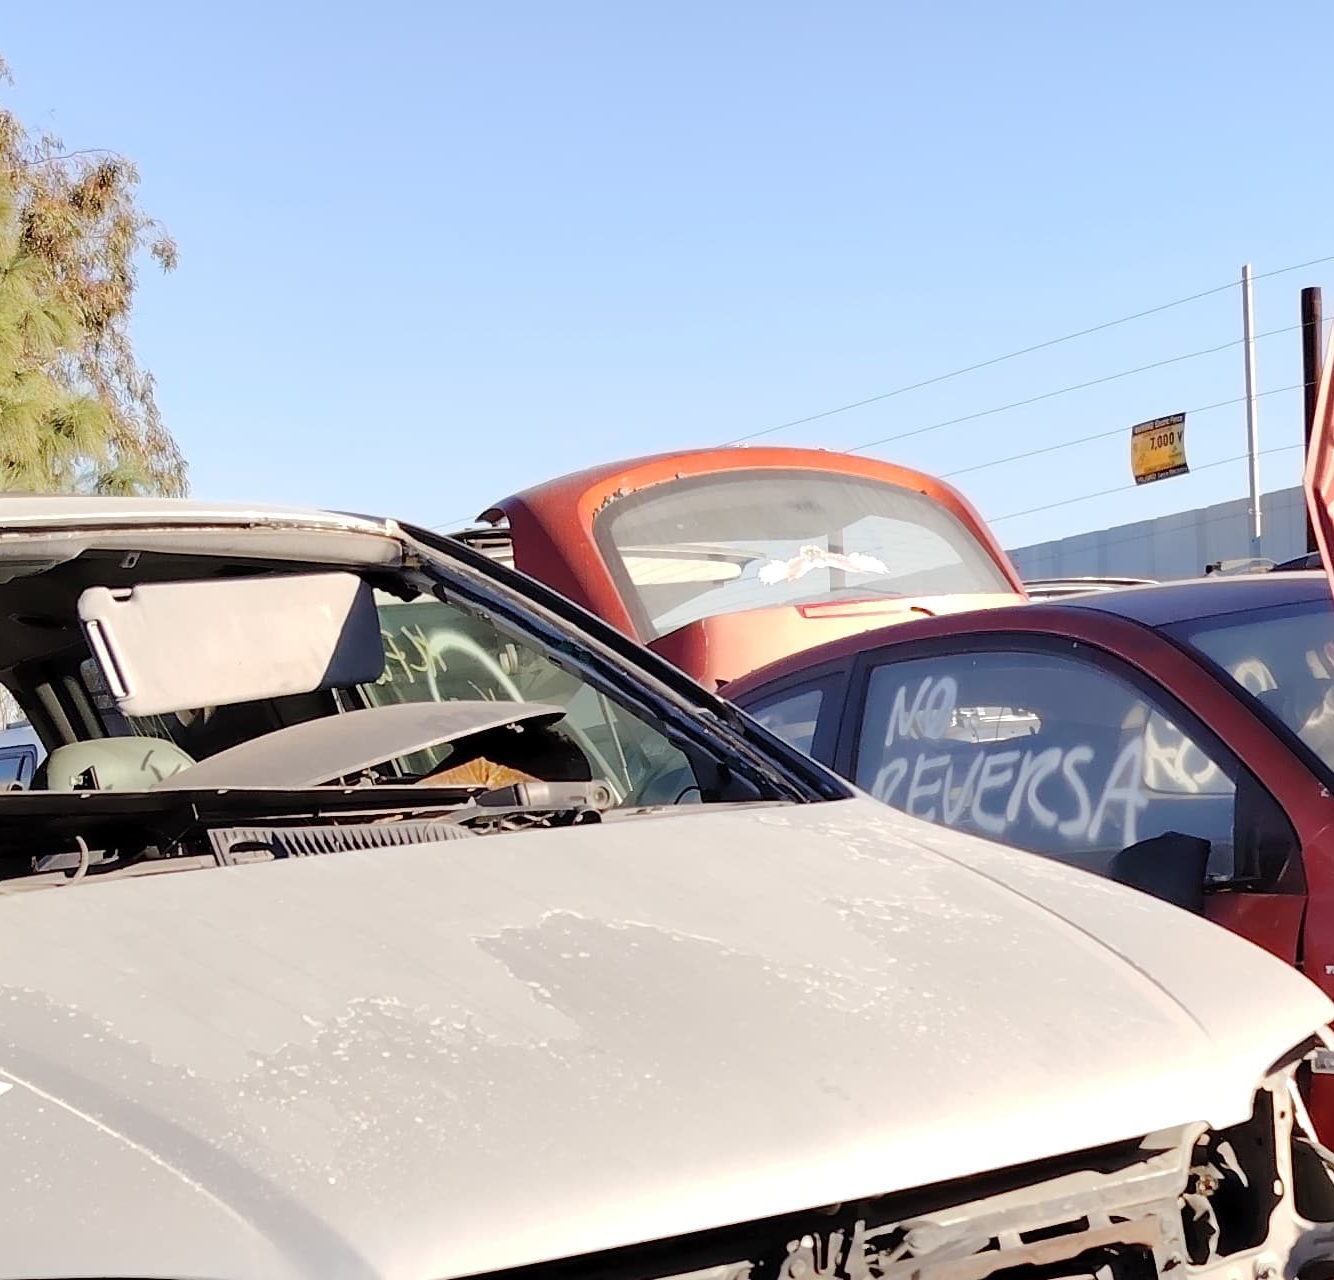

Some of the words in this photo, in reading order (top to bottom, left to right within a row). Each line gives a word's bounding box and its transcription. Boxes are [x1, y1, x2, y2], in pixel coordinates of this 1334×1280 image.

[1150, 432, 1174, 450] 7,000
[885, 675, 958, 747] NO
[871, 736, 1149, 846] REVERSA
